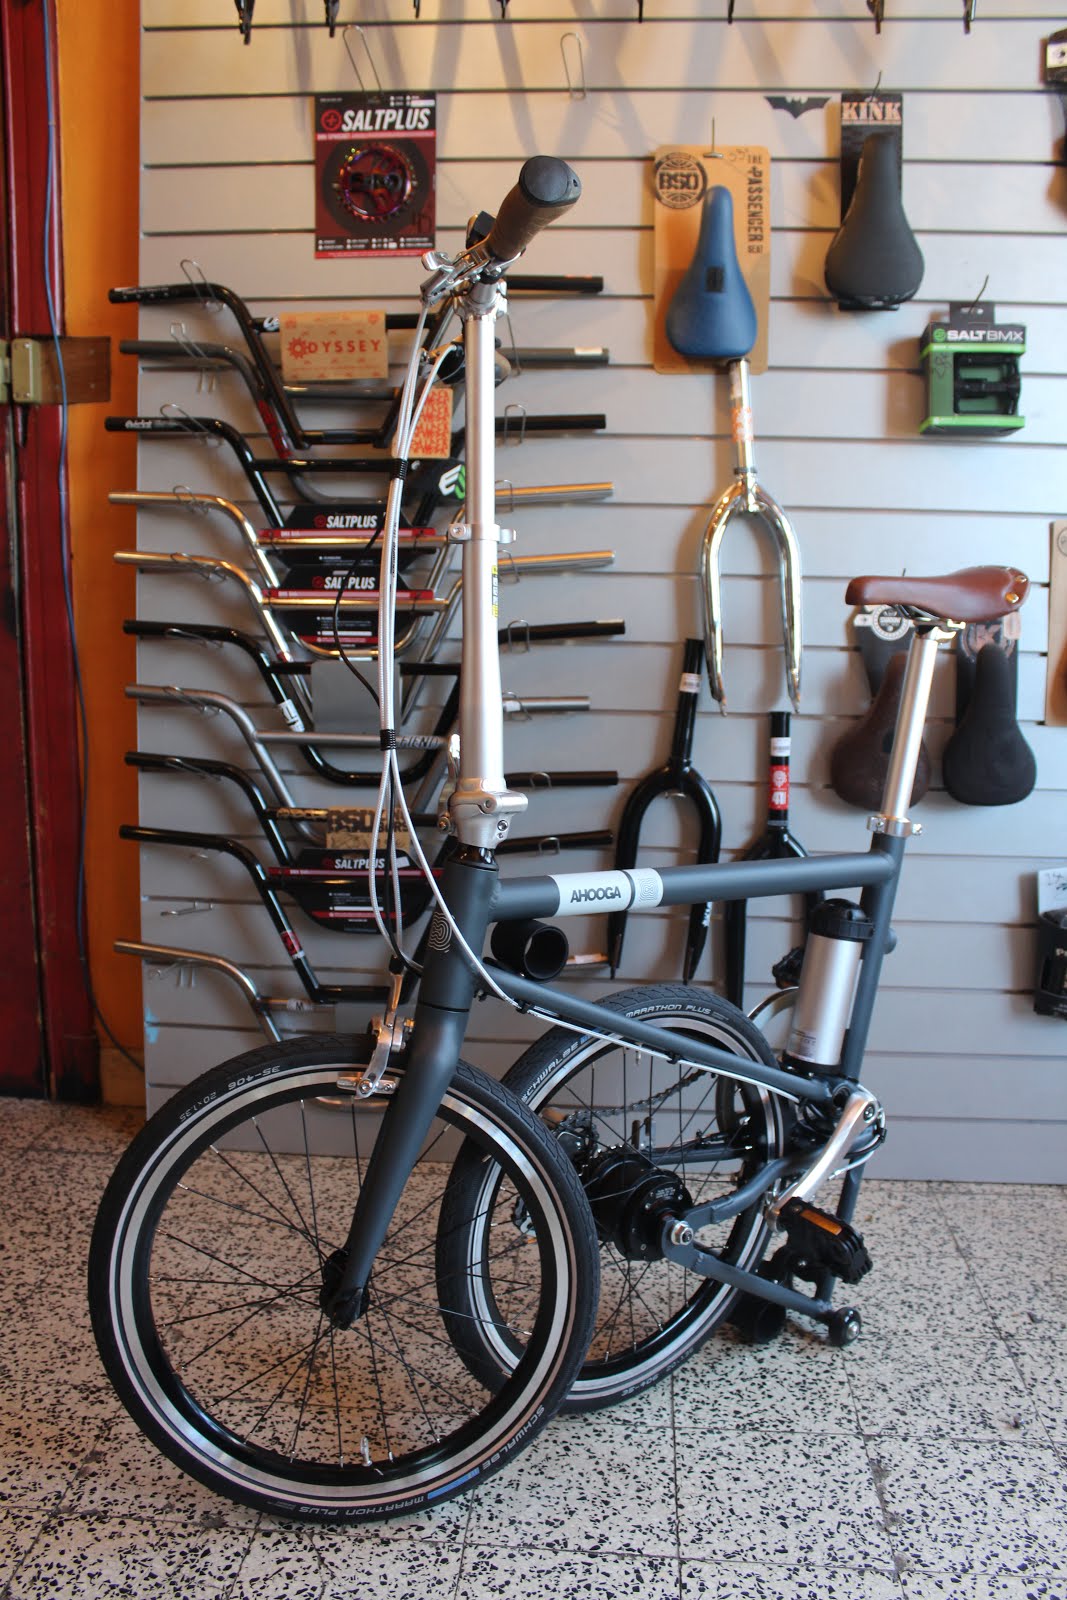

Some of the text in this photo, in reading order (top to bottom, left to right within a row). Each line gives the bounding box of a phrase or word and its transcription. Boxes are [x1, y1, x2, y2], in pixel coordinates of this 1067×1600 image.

[341, 108, 431, 132] SALTPLUS
[841, 101, 902, 121] KINK
[747, 166, 764, 242] PASSENGER
[947, 329, 1024, 342] SALTBMX
[287, 337, 381, 359] ODYSSEY
[326, 515, 378, 529] SALTPLUS
[323, 576, 376, 590] SALPLUS
[570, 886, 622, 904] AHOOGA
[624, 1003, 712, 1019] MARATHON PLUS
[227, 1065, 281, 1091] 35-406
[521, 1041, 579, 1102] SCHWALBE
[482, 1403, 546, 1471] SCHWALBE
[297, 1494, 425, 1517] MARATHON PLUS
